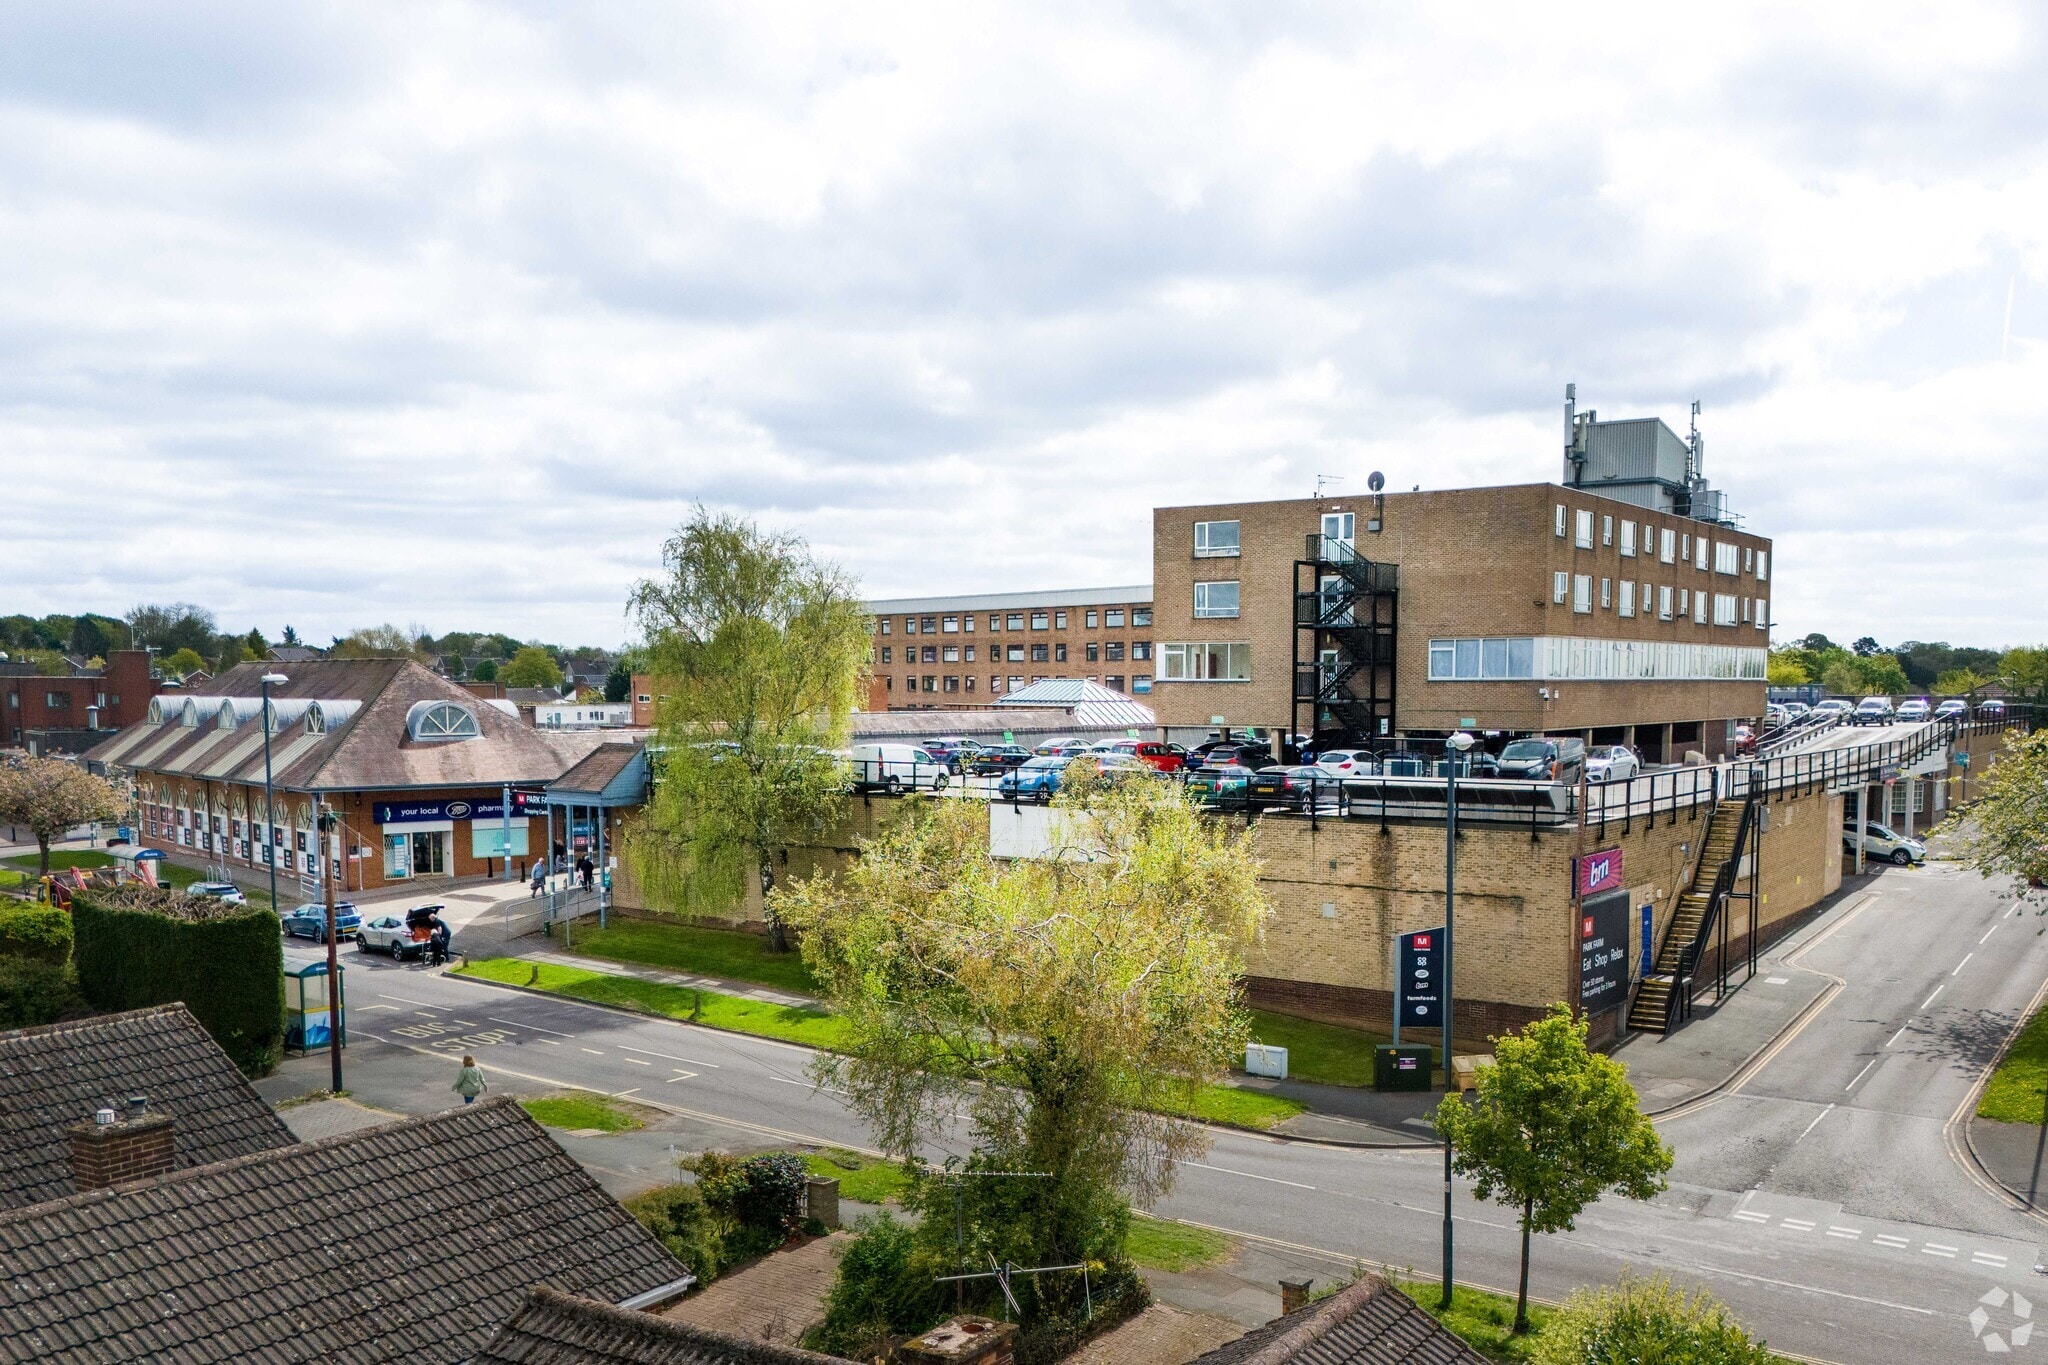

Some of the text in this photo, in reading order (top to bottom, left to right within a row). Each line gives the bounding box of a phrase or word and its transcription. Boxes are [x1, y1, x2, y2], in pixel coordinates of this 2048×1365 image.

[526, 795, 541, 804] PARK
[401, 809, 418, 817] your
[477, 805, 514, 813] pharmay
[1585, 921, 1592, 932] M
[1582, 941, 1593, 952] PARK
[1583, 947, 1624, 971] Eat Shop Relax
[390, 1022, 446, 1039] BUS
[431, 1031, 506, 1051] STOP
